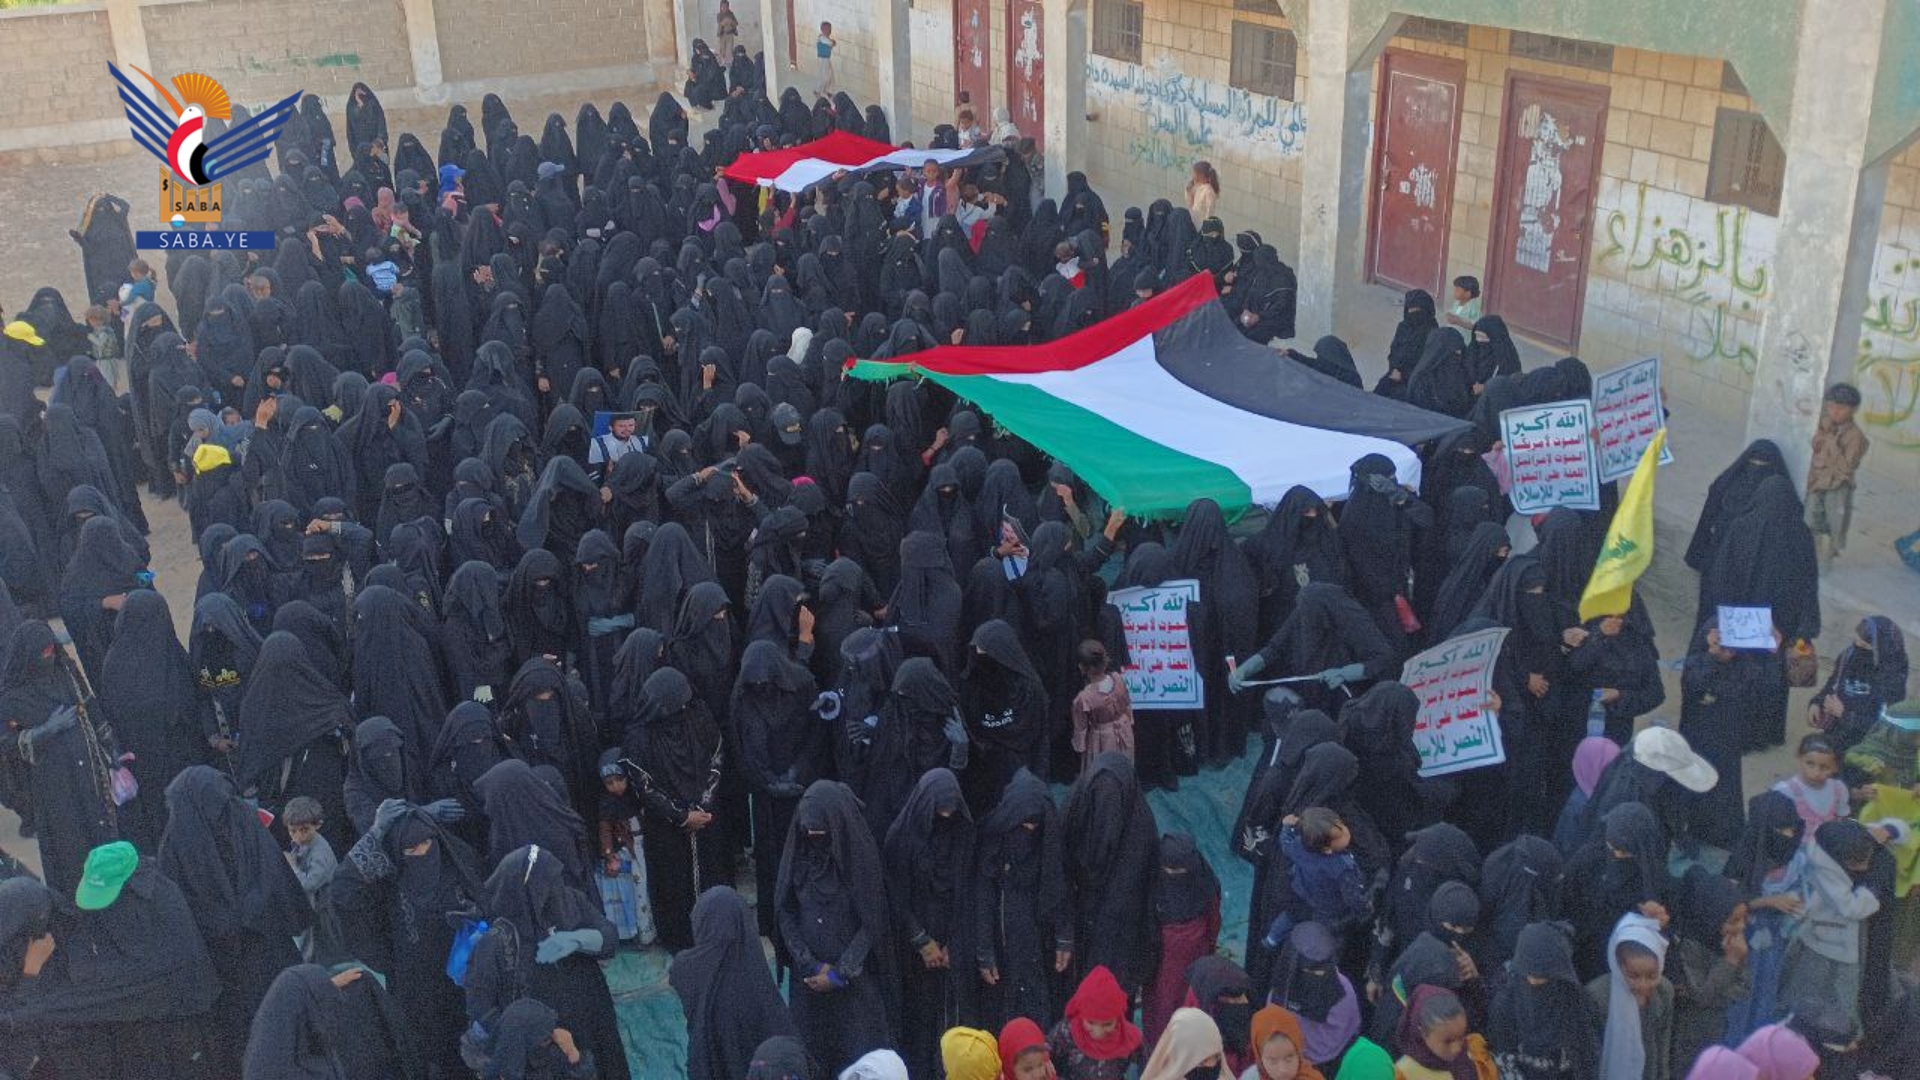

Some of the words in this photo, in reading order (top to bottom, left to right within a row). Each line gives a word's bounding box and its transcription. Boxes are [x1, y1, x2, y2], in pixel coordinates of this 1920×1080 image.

[1633, 368, 1654, 385] الله
[1511, 411, 1553, 436] أكبر
[1556, 411, 1583, 428] الله
[1554, 434, 1585, 447] الموت
[1555, 451, 1586, 464] الموت
[1558, 481, 1589, 502] النصر
[1163, 592, 1189, 611] الله
[1463, 639, 1493, 660] الله
[1159, 675, 1194, 697] النصر
[1452, 725, 1489, 756] النصر
